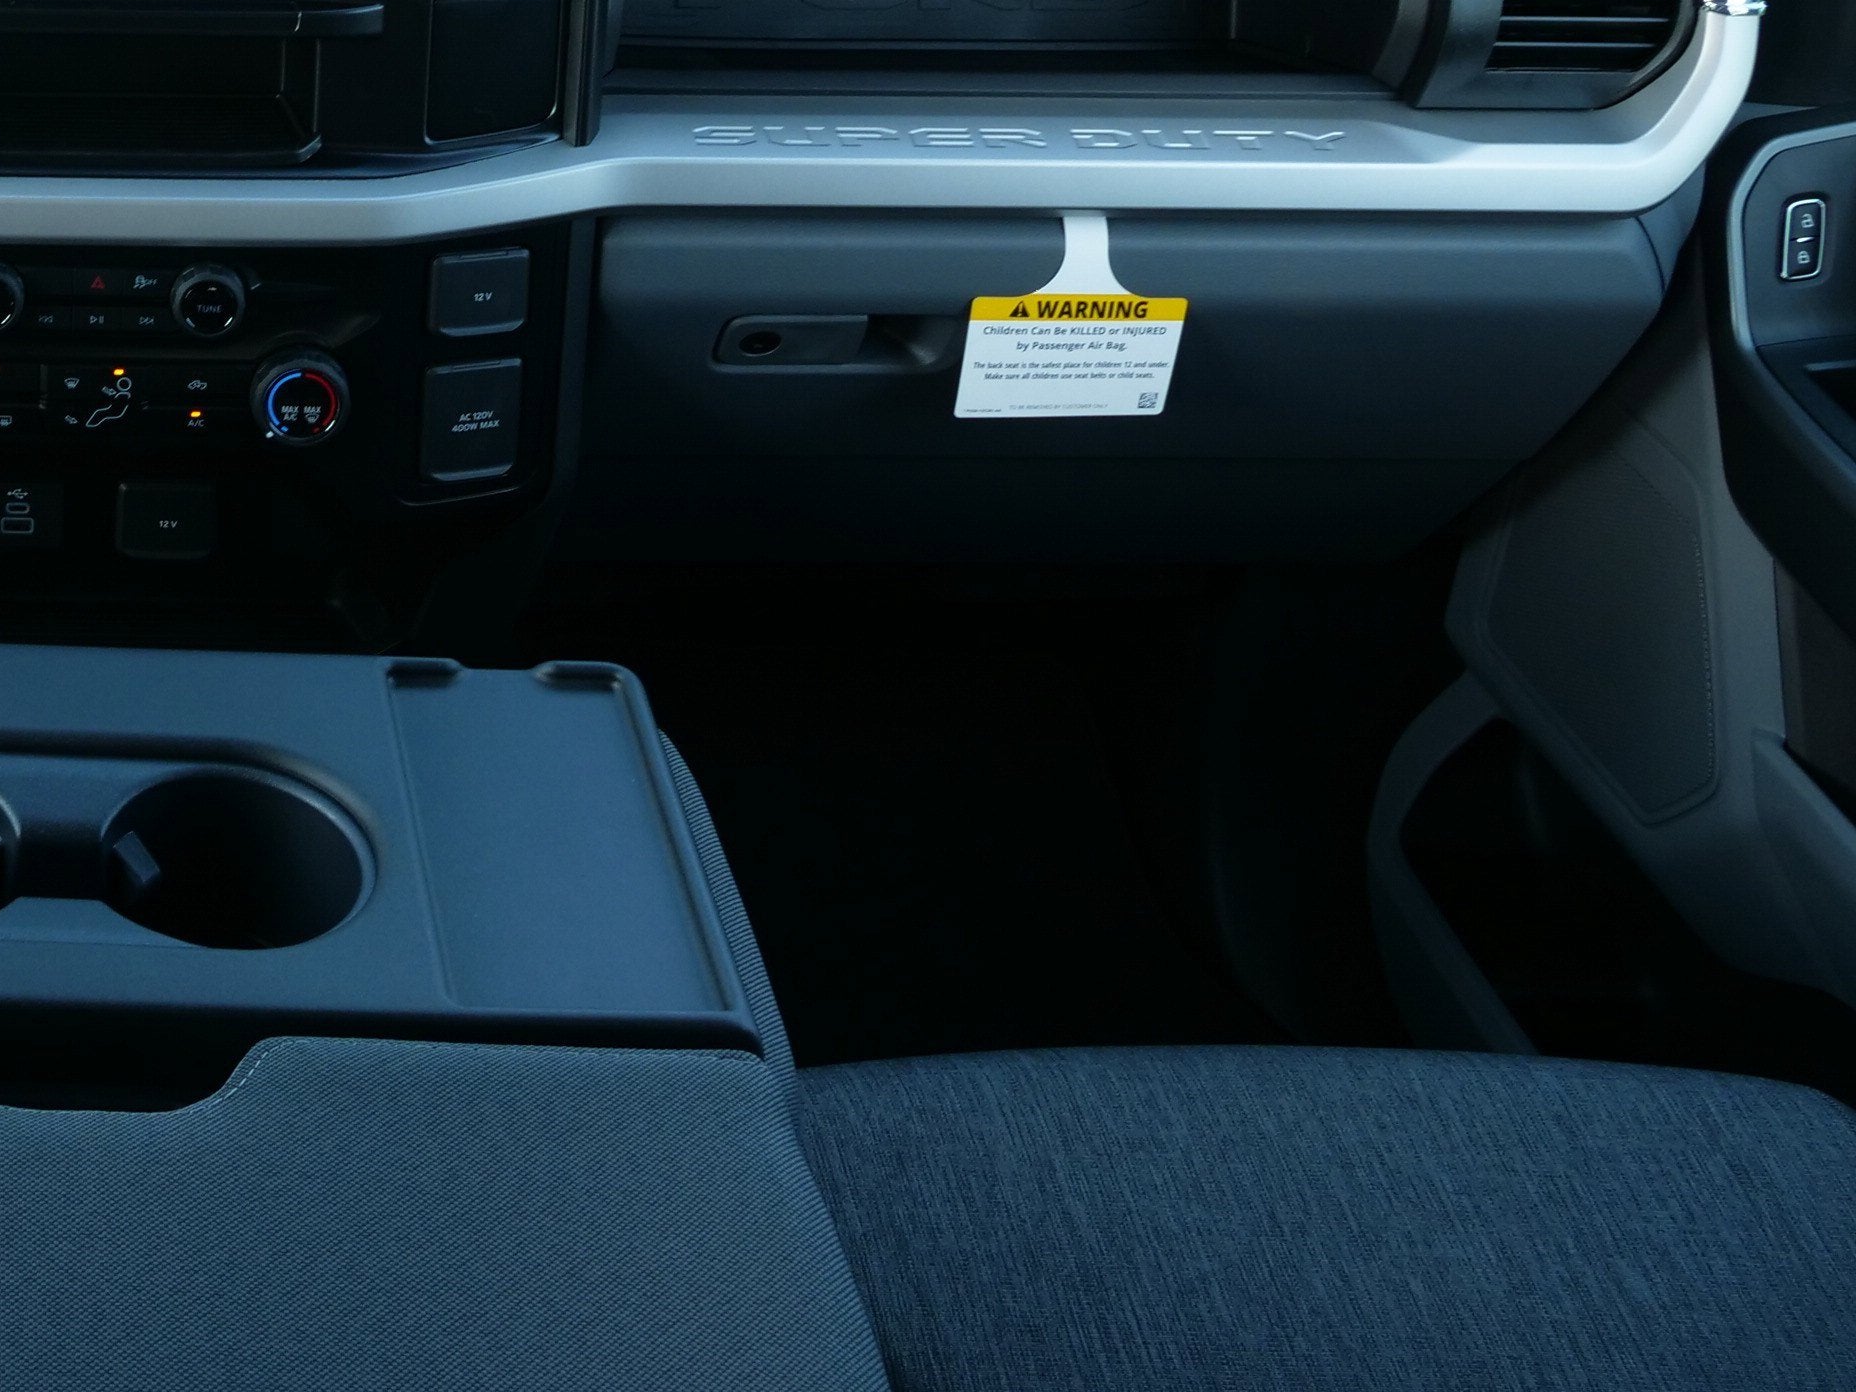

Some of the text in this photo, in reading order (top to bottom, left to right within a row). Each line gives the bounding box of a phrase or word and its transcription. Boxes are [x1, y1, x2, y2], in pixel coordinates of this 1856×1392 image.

[691, 124, 1348, 152] SUPER DUTY
[196, 303, 223, 314] TUNE
[1037, 300, 1150, 319] WARNING
[982, 325, 1167, 337] Children Can Be KILLED or INJURED
[1016, 341, 1030, 352] by
[1032, 340, 1086, 353] Passenger
[1087, 340, 1102, 351] Air
[281, 404, 299, 414] MAX
[304, 404, 322, 414] MAX
[459, 409, 494, 423] AC 120V
[187, 419, 205, 428] A/C
[451, 418, 500, 434] 400W MAX
